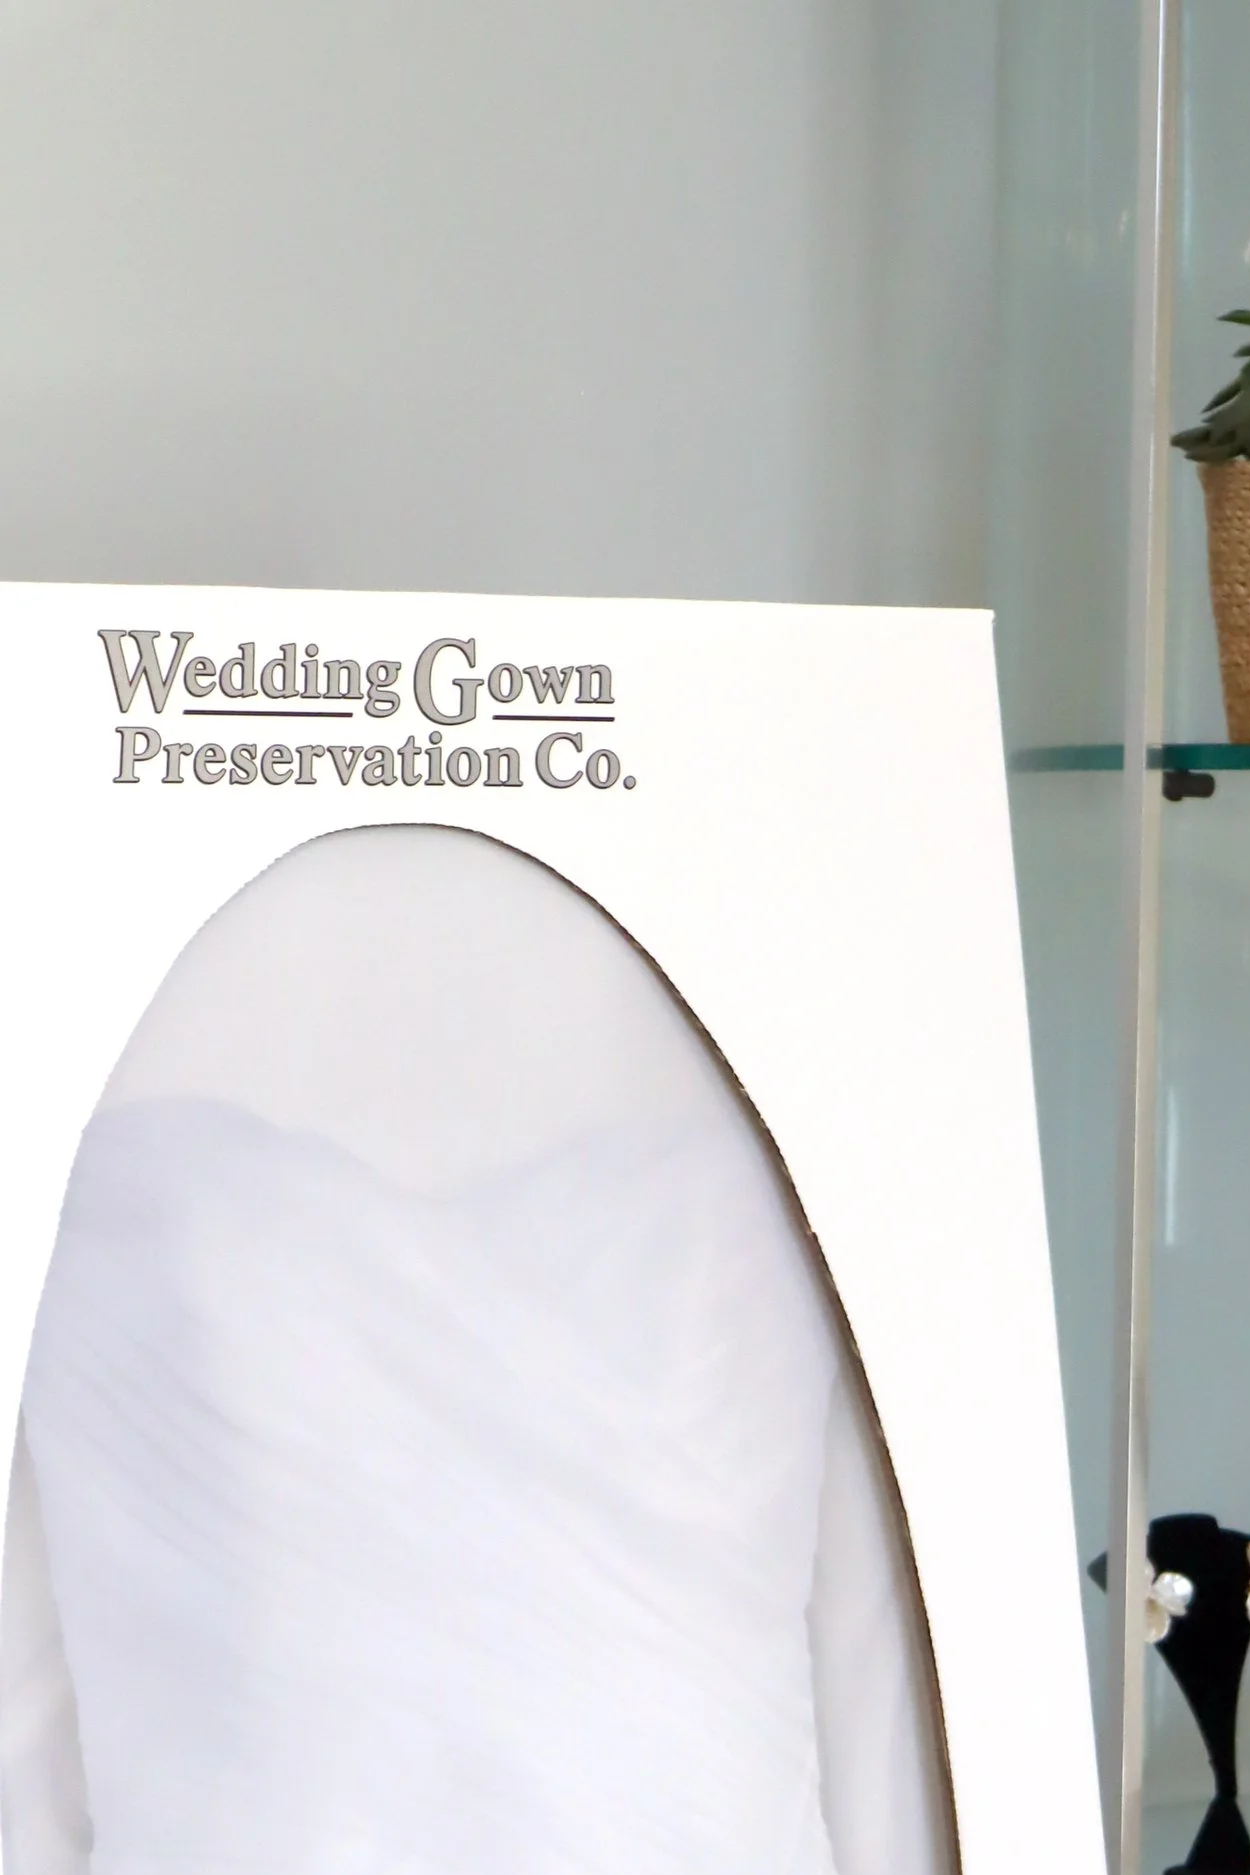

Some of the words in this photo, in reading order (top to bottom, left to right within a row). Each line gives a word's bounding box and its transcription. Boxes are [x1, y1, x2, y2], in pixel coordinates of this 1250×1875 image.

[97, 629, 401, 718] Wedding
[413, 637, 615, 726] Gown
[113, 726, 523, 787] Preservation
[535, 731, 637, 790] Co.
